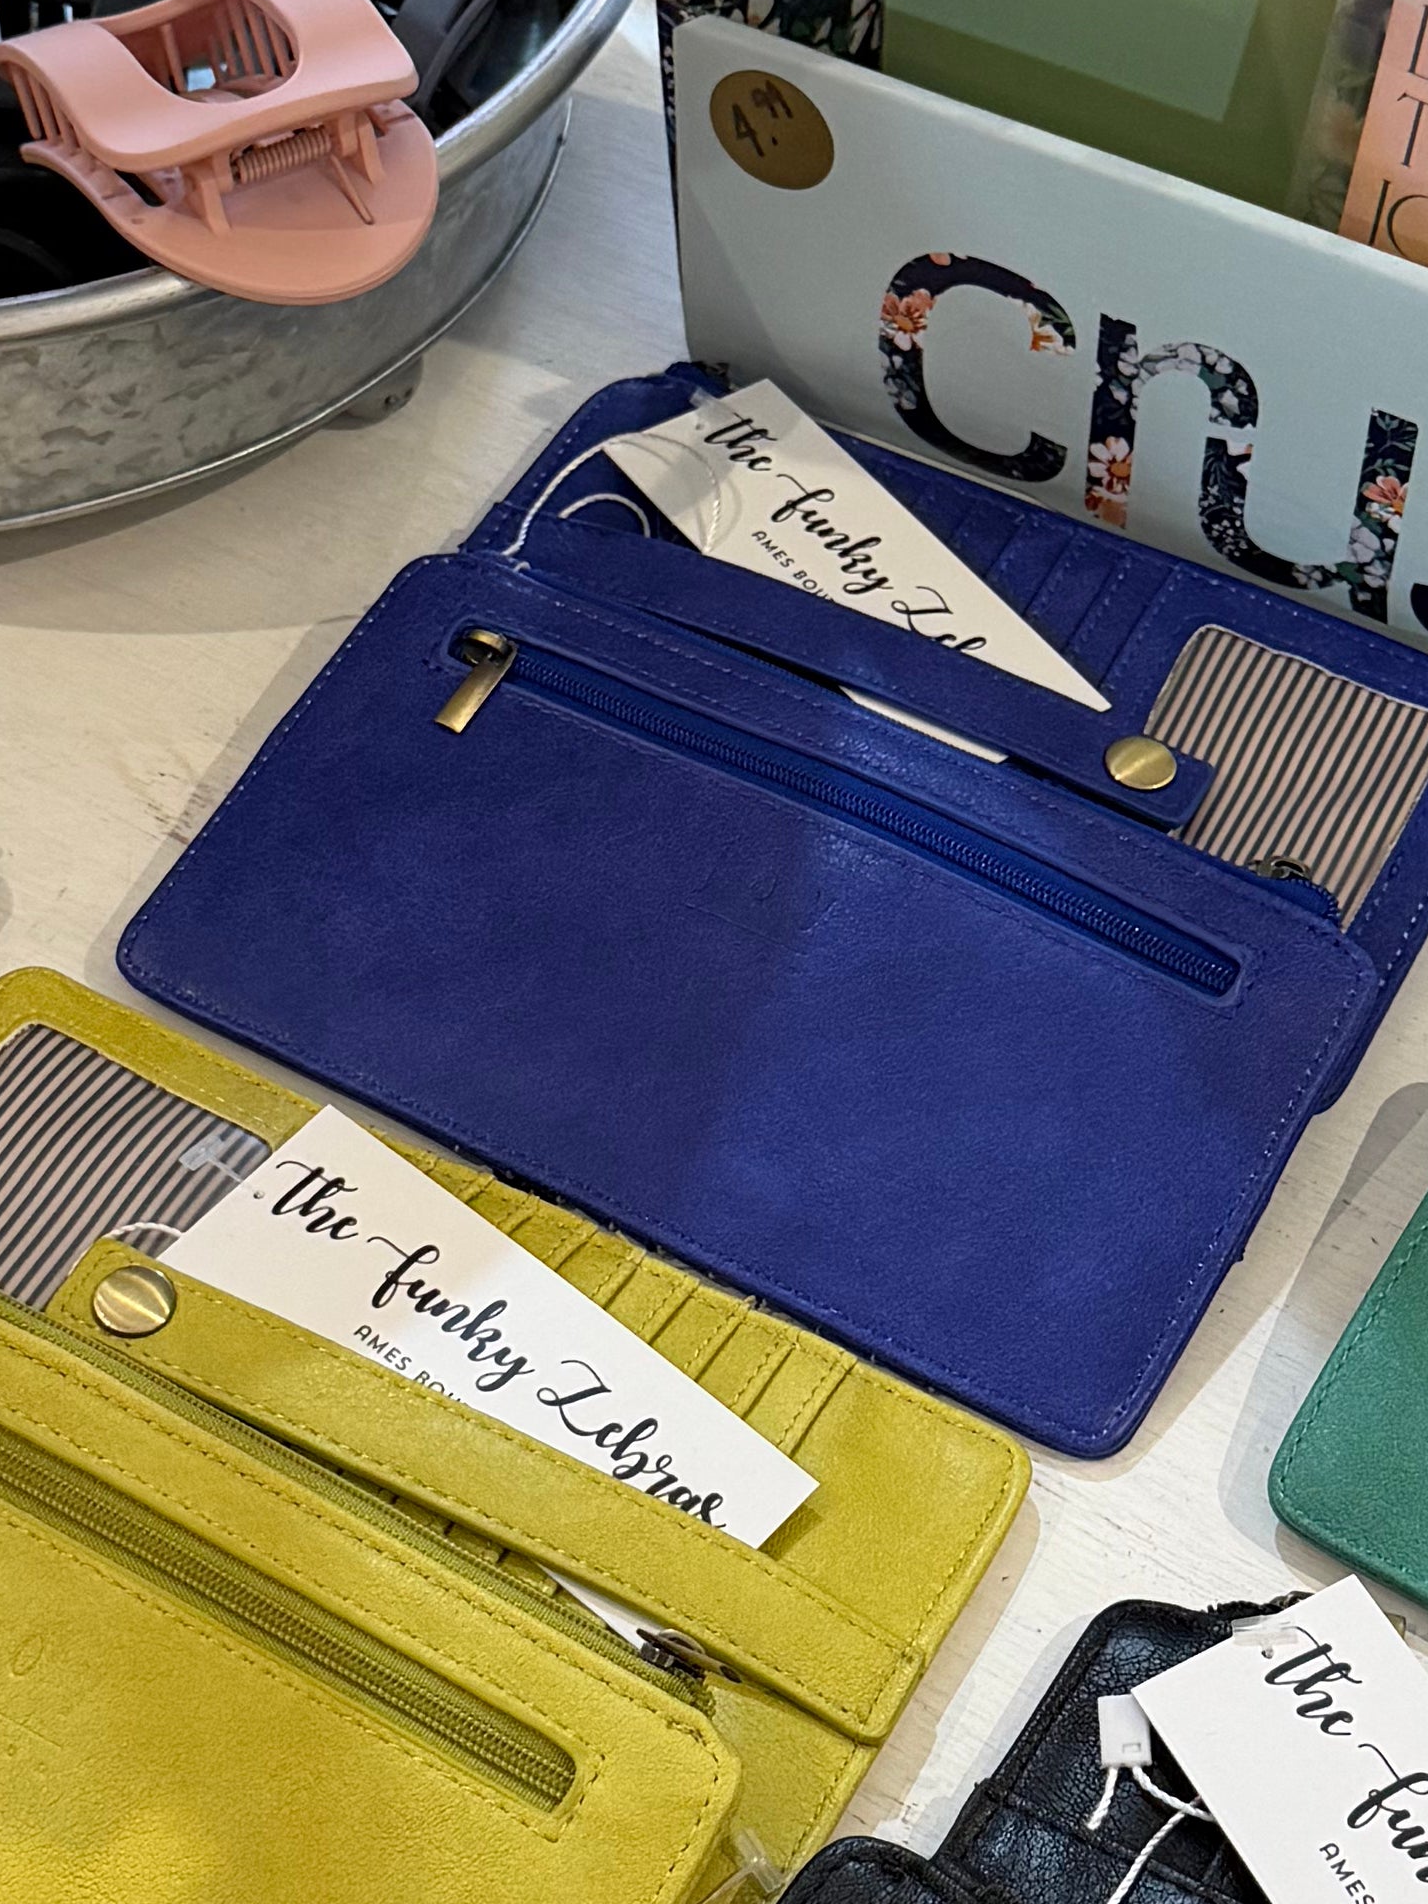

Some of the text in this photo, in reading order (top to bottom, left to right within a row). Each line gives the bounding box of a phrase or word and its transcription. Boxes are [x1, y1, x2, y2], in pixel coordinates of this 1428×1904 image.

[704, 410, 773, 472] the
[775, 472, 893, 595] funky
[752, 531, 795, 569] AMES
[271, 1159, 727, 1529] the funky Zebras
[352, 1324, 412, 1372] AMES
[1263, 1623, 1362, 1738] the
